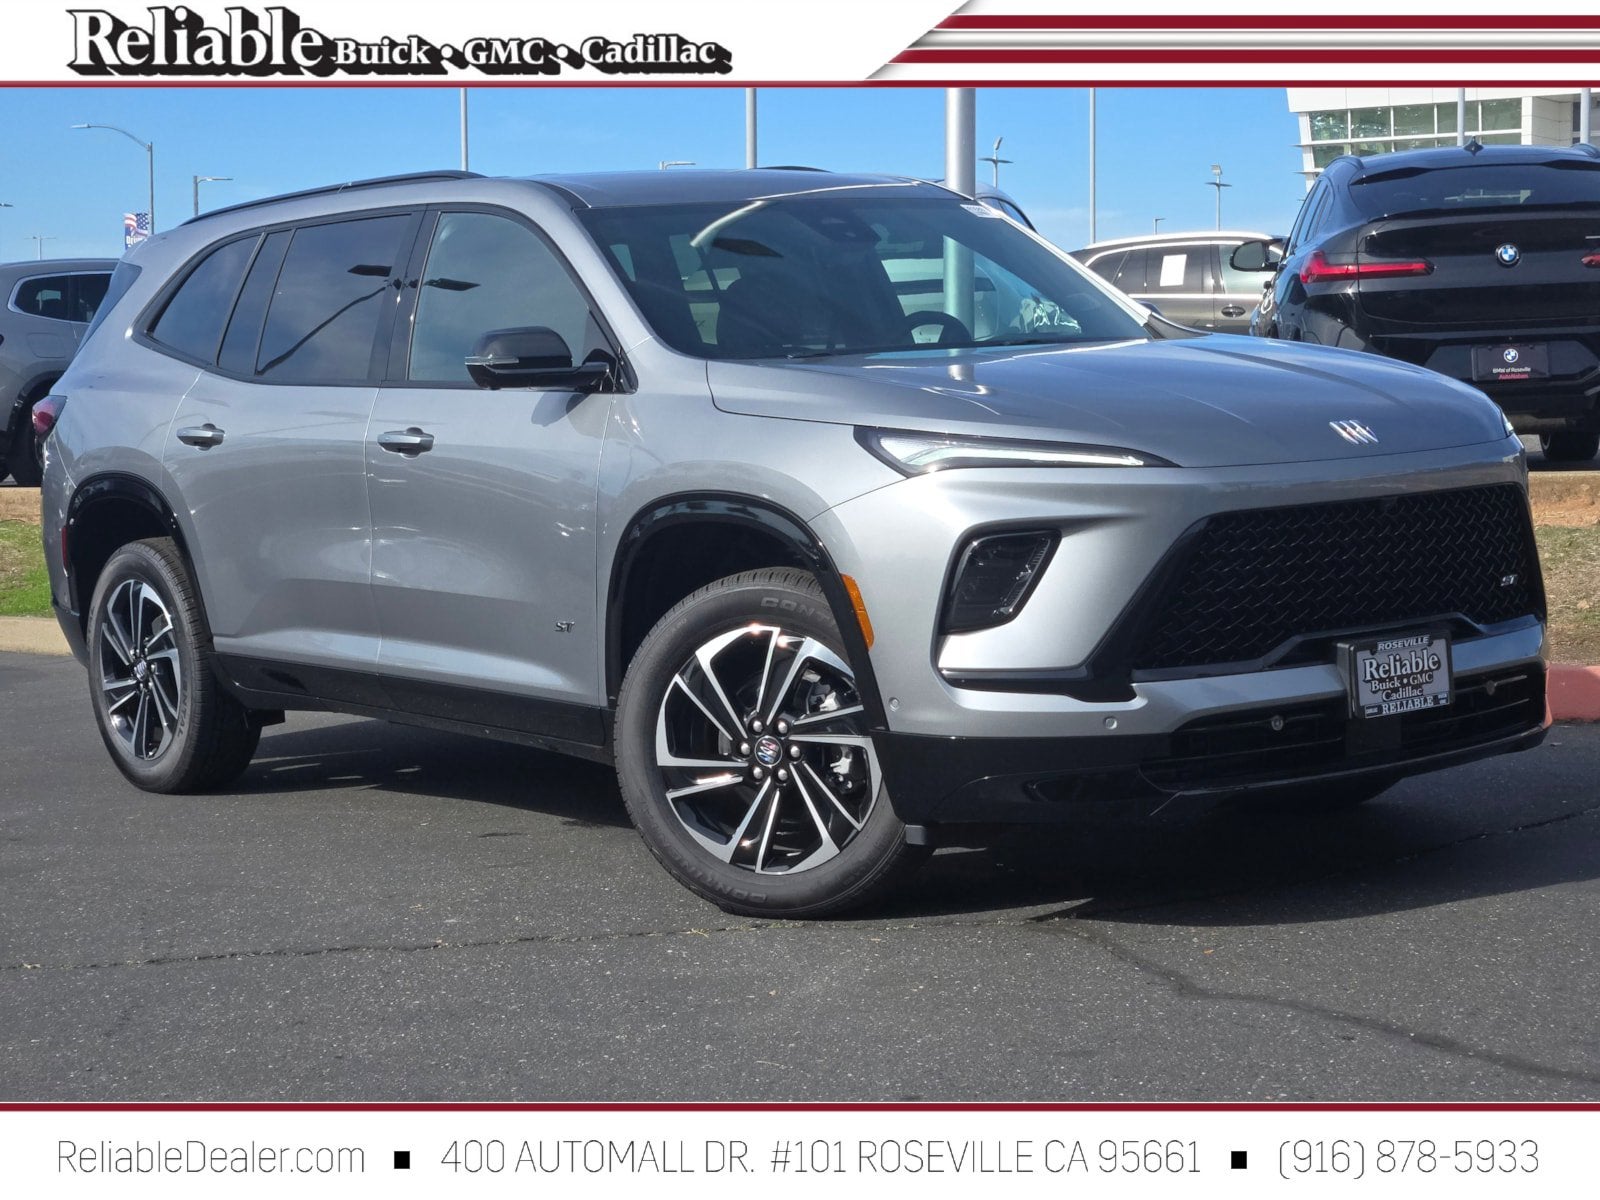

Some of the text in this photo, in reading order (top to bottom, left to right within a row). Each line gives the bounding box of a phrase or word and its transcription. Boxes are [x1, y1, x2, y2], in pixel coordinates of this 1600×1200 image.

[1501, 574, 1518, 587] ST
[555, 621, 575, 633] ST
[1378, 636, 1430, 651] ROSEVILLE
[1364, 648, 1439, 681] Reliable
[1371, 672, 1433, 691] Buick GMC
[1381, 687, 1424, 702] Cadillac
[1382, 697, 1433, 714] RELIABLE
